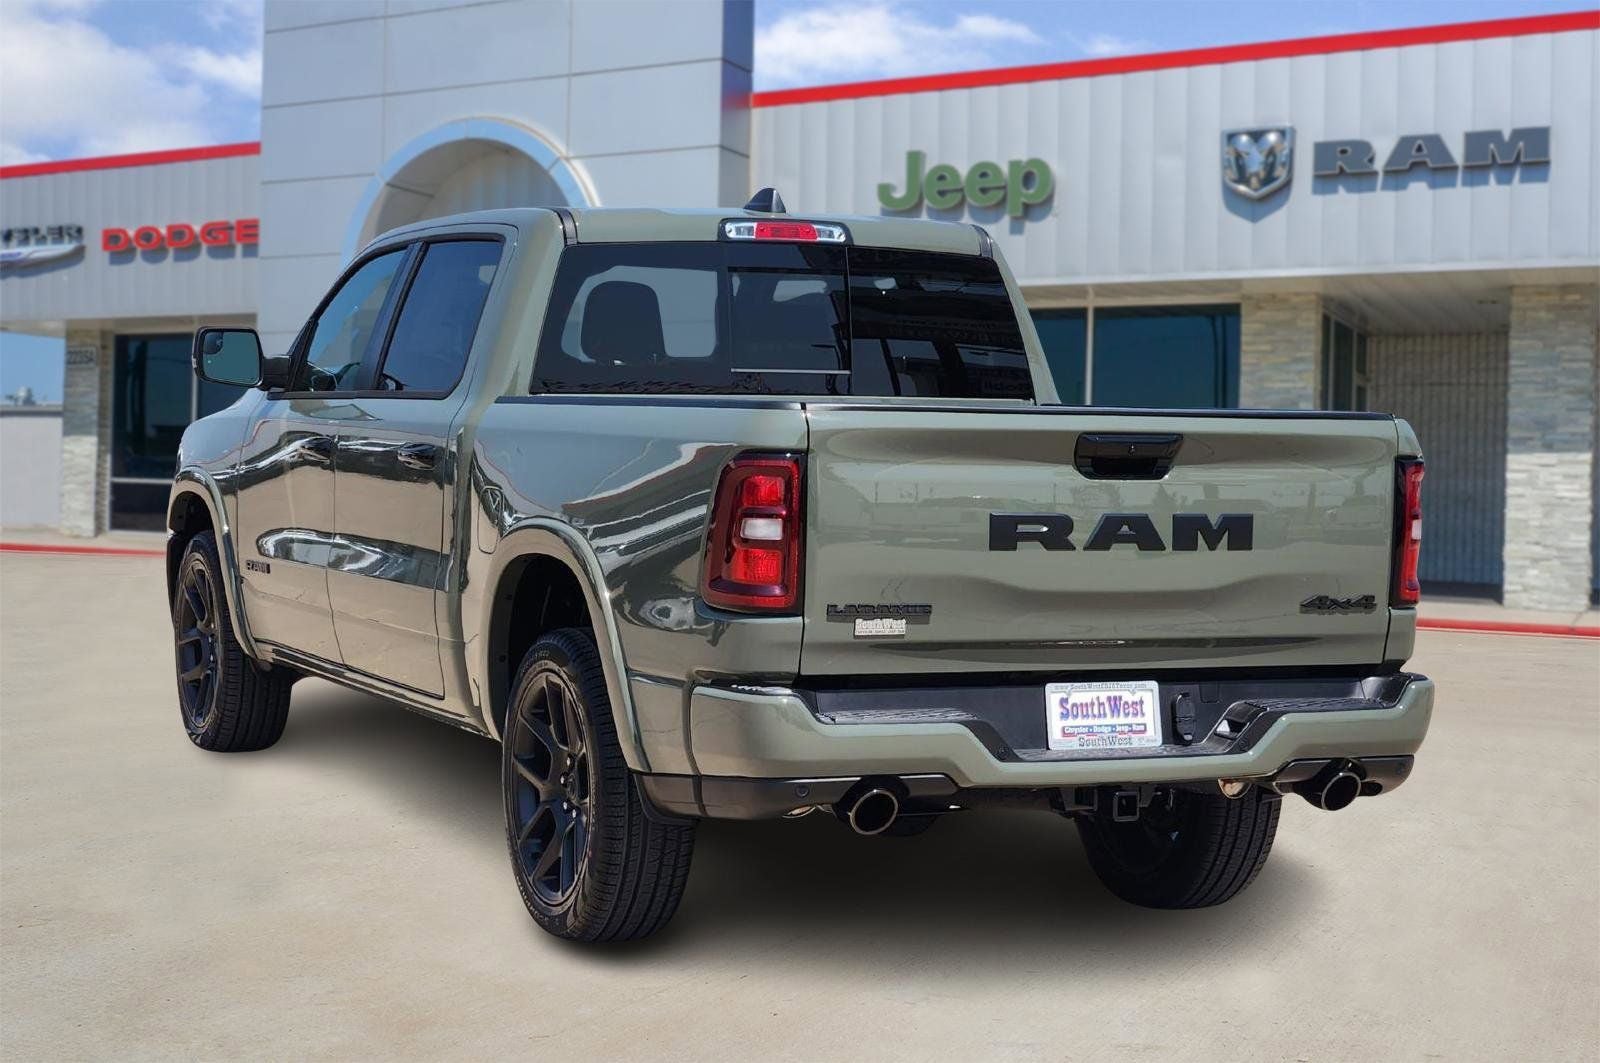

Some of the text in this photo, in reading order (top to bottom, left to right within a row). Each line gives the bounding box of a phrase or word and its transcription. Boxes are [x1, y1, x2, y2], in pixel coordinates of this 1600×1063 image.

[1313, 126, 1551, 175] RAM
[877, 150, 1053, 217] Jeep
[102, 218, 260, 252] DODGE
[989, 512, 1253, 551] RAM
[1059, 695, 1146, 720] SouthWest
[1079, 736, 1133, 747] SouthWest
